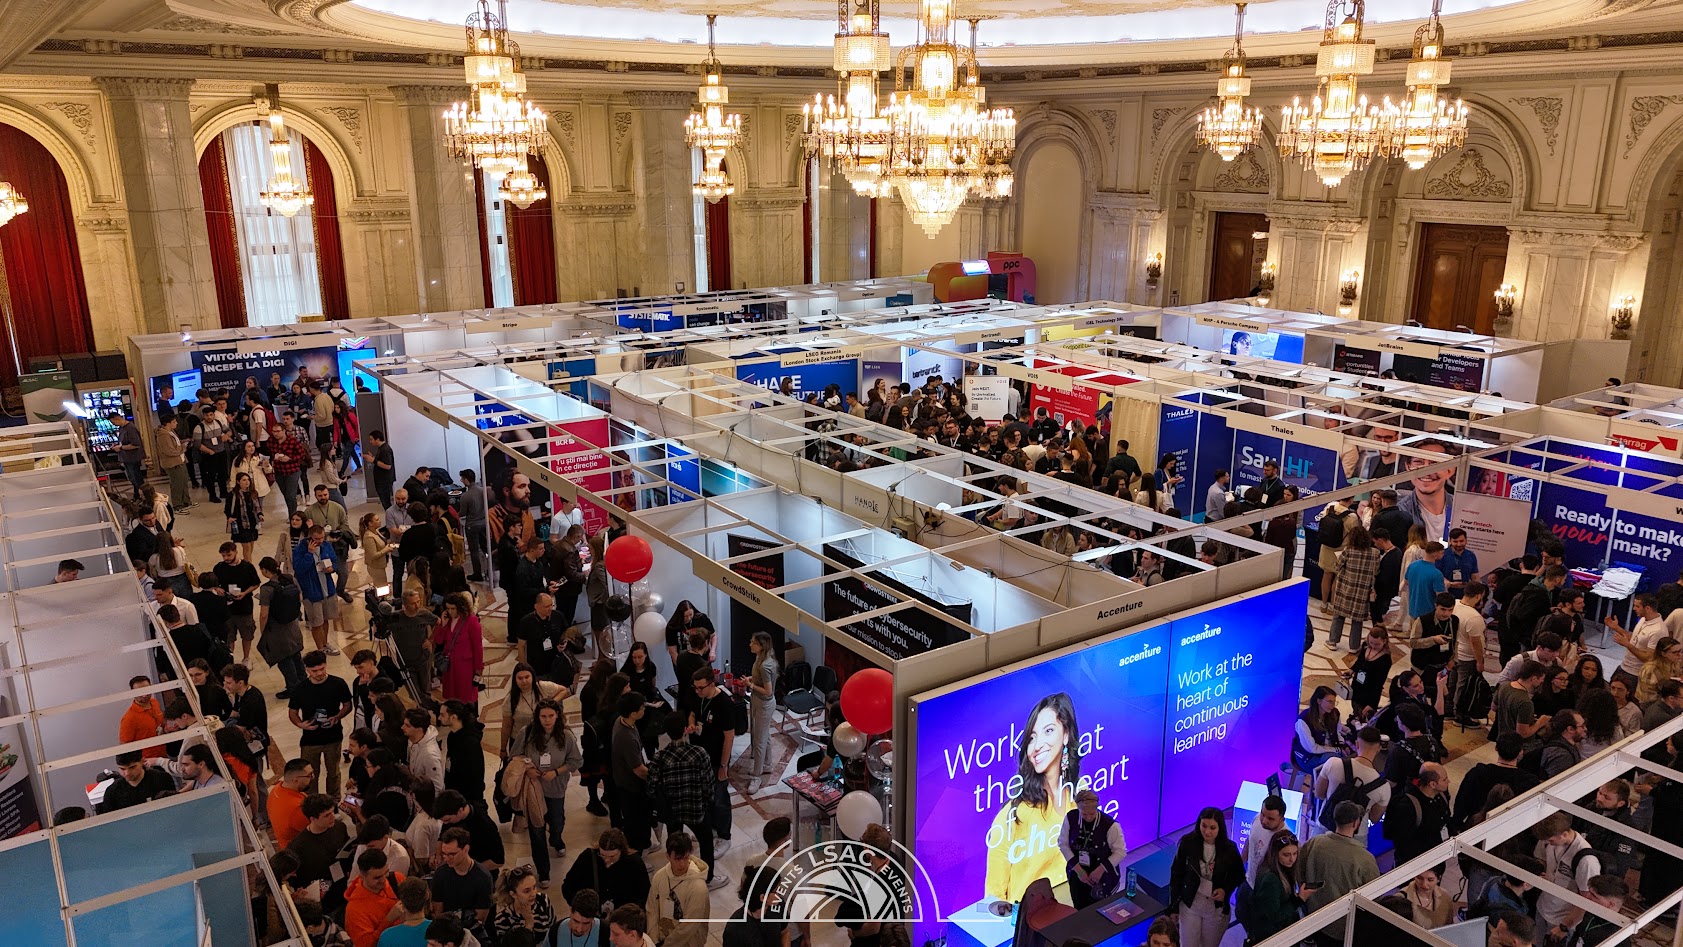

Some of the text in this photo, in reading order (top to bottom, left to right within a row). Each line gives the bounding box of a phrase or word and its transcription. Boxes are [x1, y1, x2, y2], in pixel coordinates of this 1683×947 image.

[1003, 260, 1020, 270] ppc
[628, 312, 670, 321] SYSTEMATIC
[204, 352, 257, 362] VIITORUL
[820, 354, 845, 362] Exchange
[845, 351, 862, 359] Group)
[1377, 342, 1404, 350] JetBrains
[202, 359, 285, 372] ÎNCEPE LA DIGI
[1443, 356, 1480, 368] Developers
[1445, 363, 1465, 373] Teams
[753, 374, 802, 391] HAE
[1271, 424, 1294, 436] Thales
[1554, 505, 1612, 532] Ready
[1615, 519, 1636, 535] to
[1551, 523, 1672, 562] your mark?
[747, 563, 767, 573] future
[722, 576, 760, 605] CrowdStrike
[833, 582, 933, 649] The future of cybersecurity
[1096, 601, 1143, 620] Accenture
[857, 628, 878, 647] mission
[878, 641, 885, 651] to
[885, 644, 899, 660] stop
[874, 623, 892, 639] with
[892, 631, 909, 650] you.
[1181, 626, 1222, 647] accenture
[1119, 645, 1162, 667] accenture
[1178, 652, 1253, 689] Work at the
[1176, 676, 1229, 712] heart of
[1174, 695, 1249, 733] continuous
[1173, 722, 1227, 755] learning
[943, 722, 1104, 780] Work at
[973, 755, 1130, 813] the heart
[985, 799, 1119, 865] of chae
